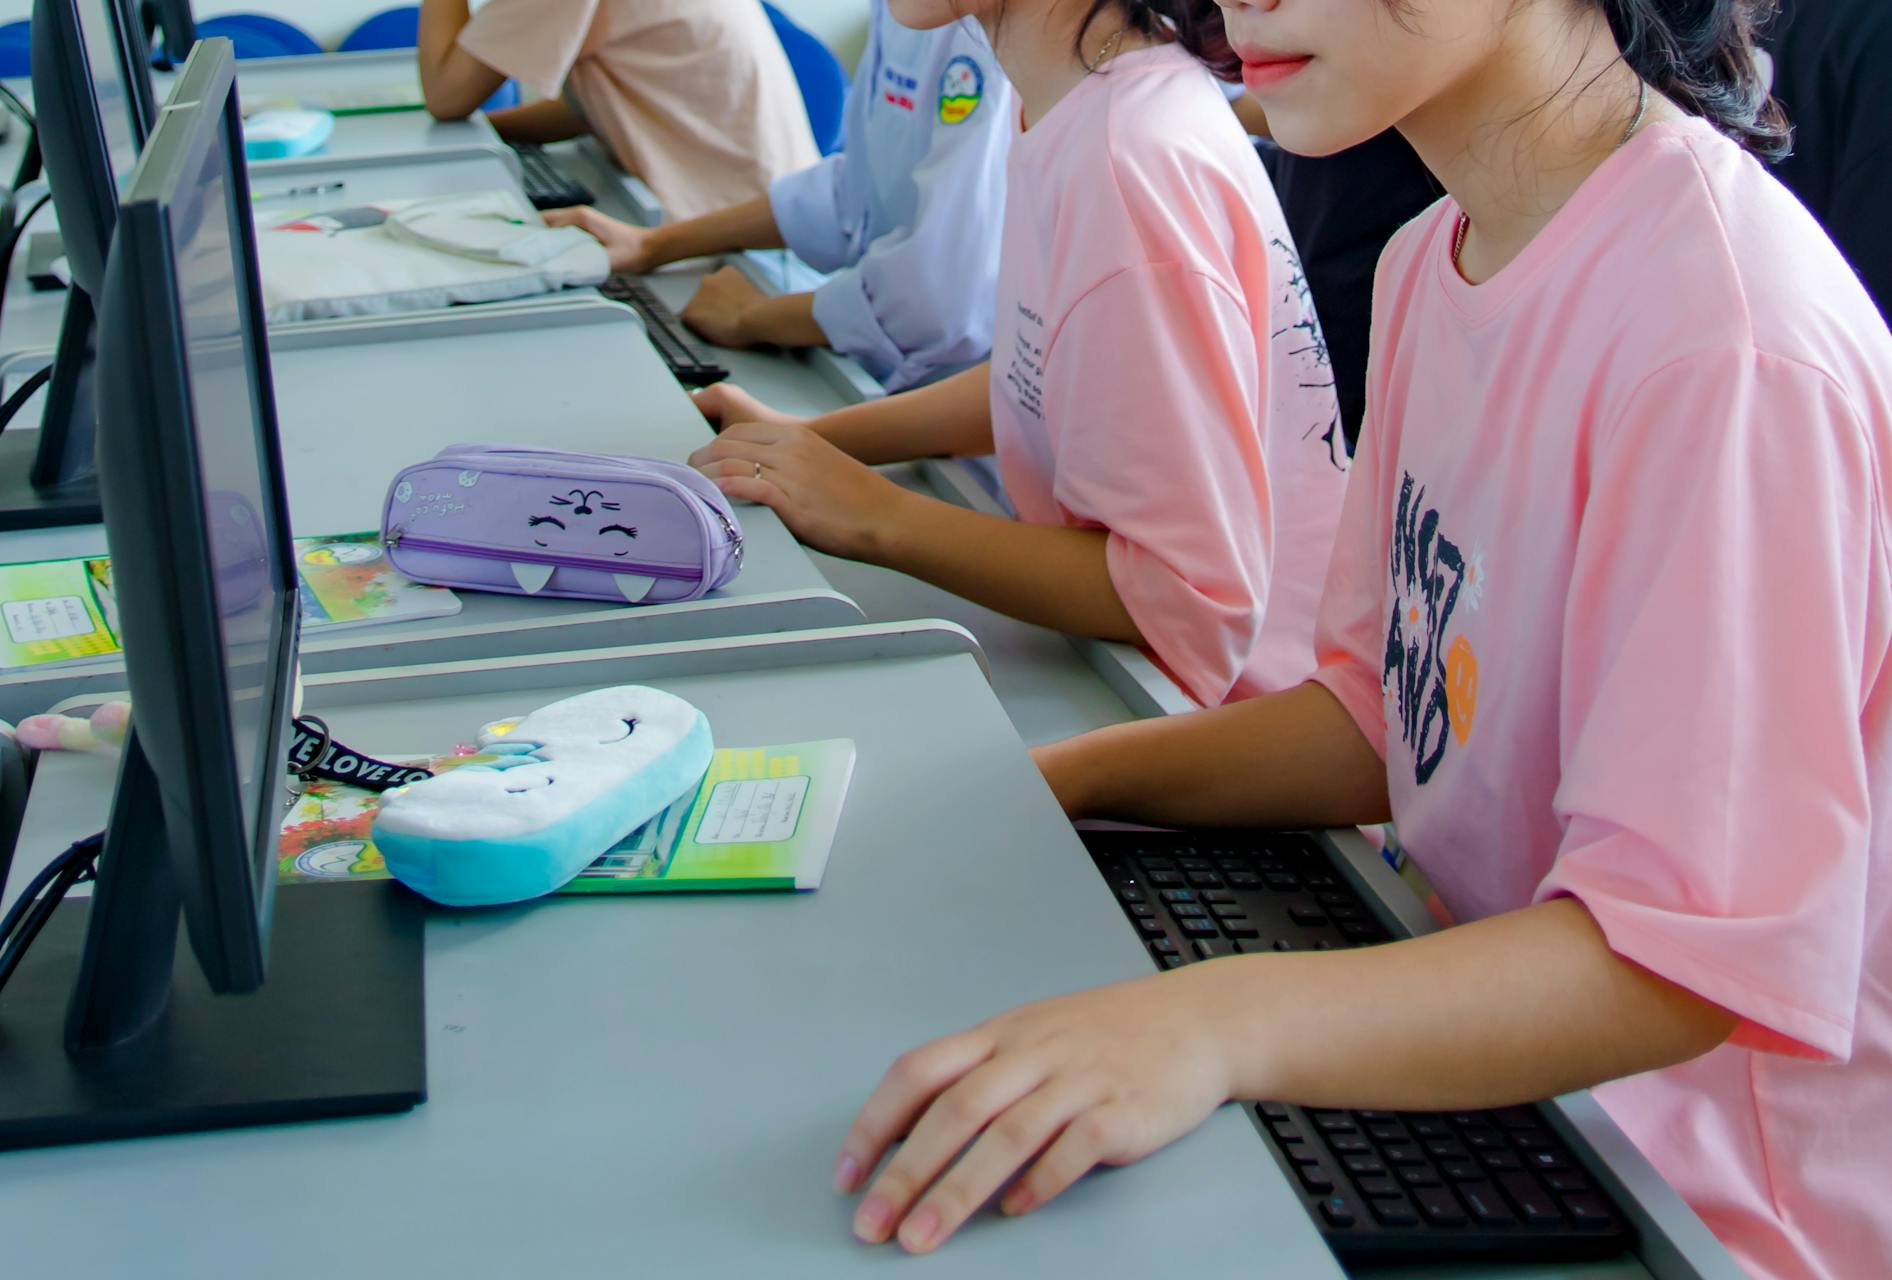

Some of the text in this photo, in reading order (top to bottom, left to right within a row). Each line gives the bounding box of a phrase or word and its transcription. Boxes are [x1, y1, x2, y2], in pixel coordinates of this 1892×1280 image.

[288, 724, 429, 784] VE LOVE LO
